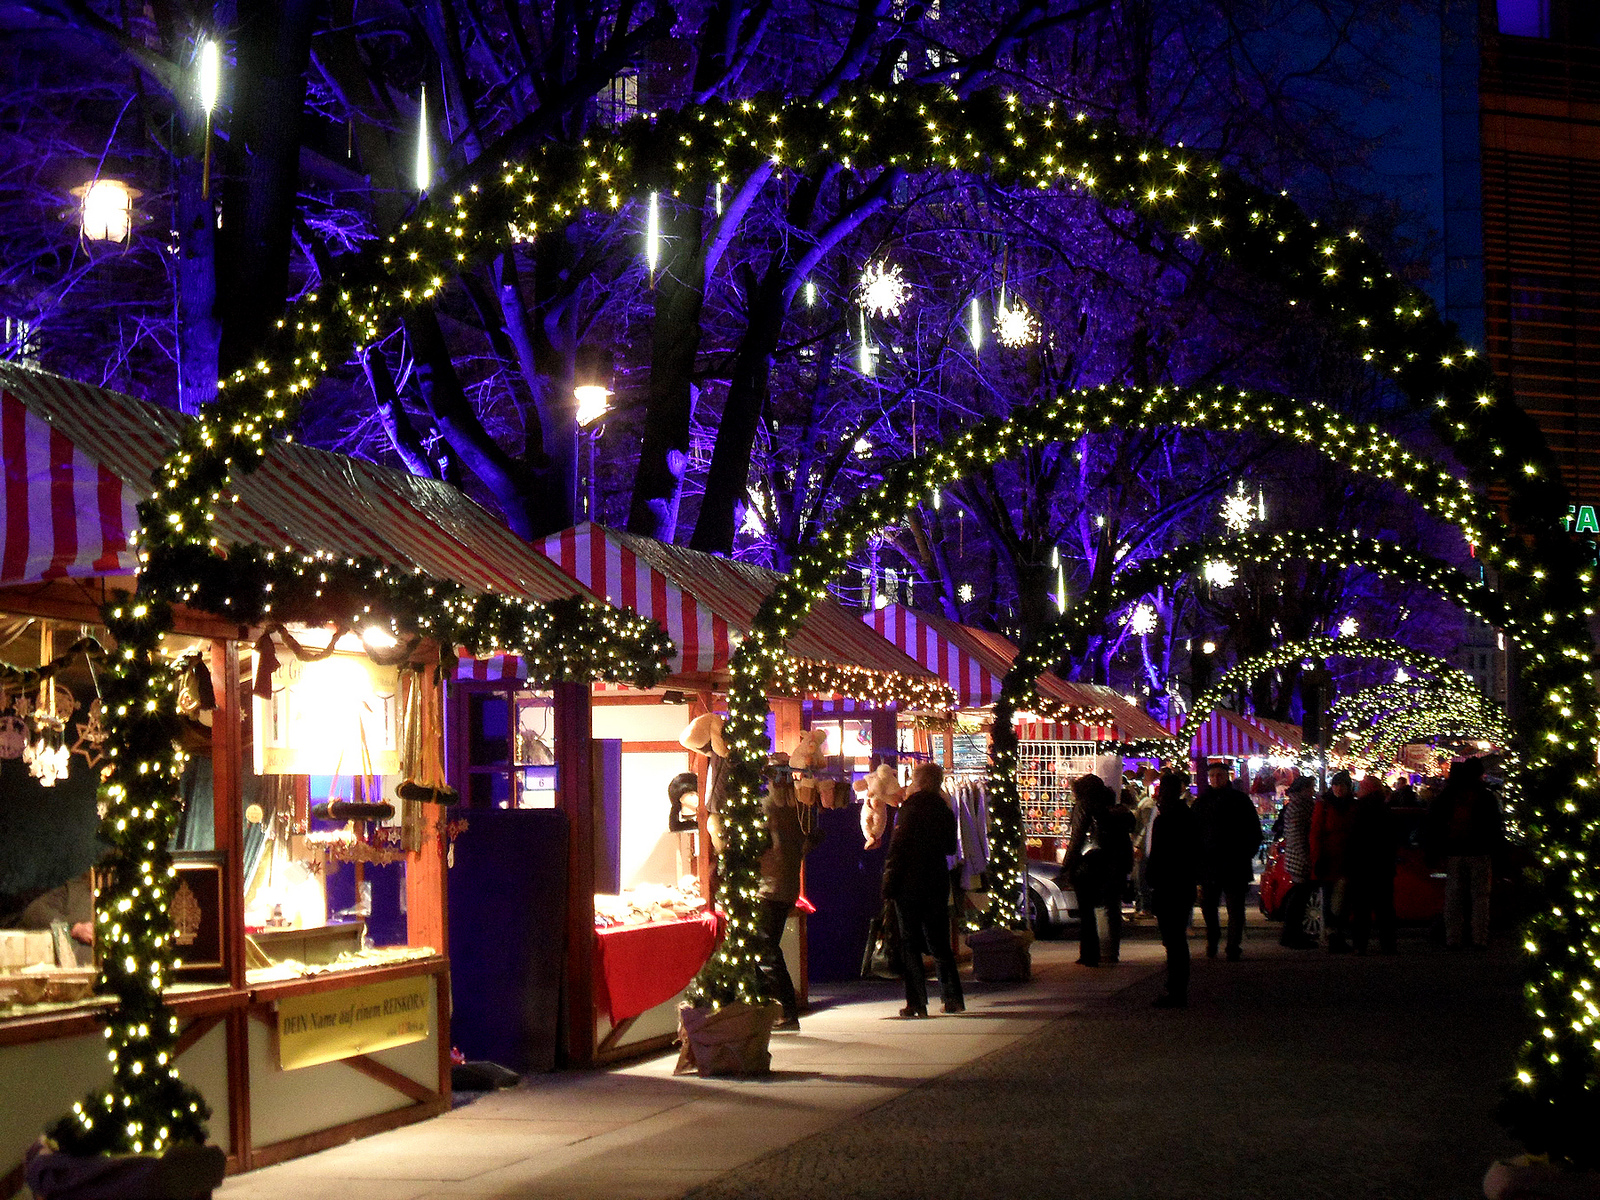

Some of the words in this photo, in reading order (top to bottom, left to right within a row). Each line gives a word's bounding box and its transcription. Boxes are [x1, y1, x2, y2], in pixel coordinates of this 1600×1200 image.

[538, 778, 545, 788] 6
[283, 1014, 307, 1035] DEIN
[310, 1011, 337, 1030] Name
[338, 1003, 355, 1026] auf
[355, 1004, 381, 1021] einem
